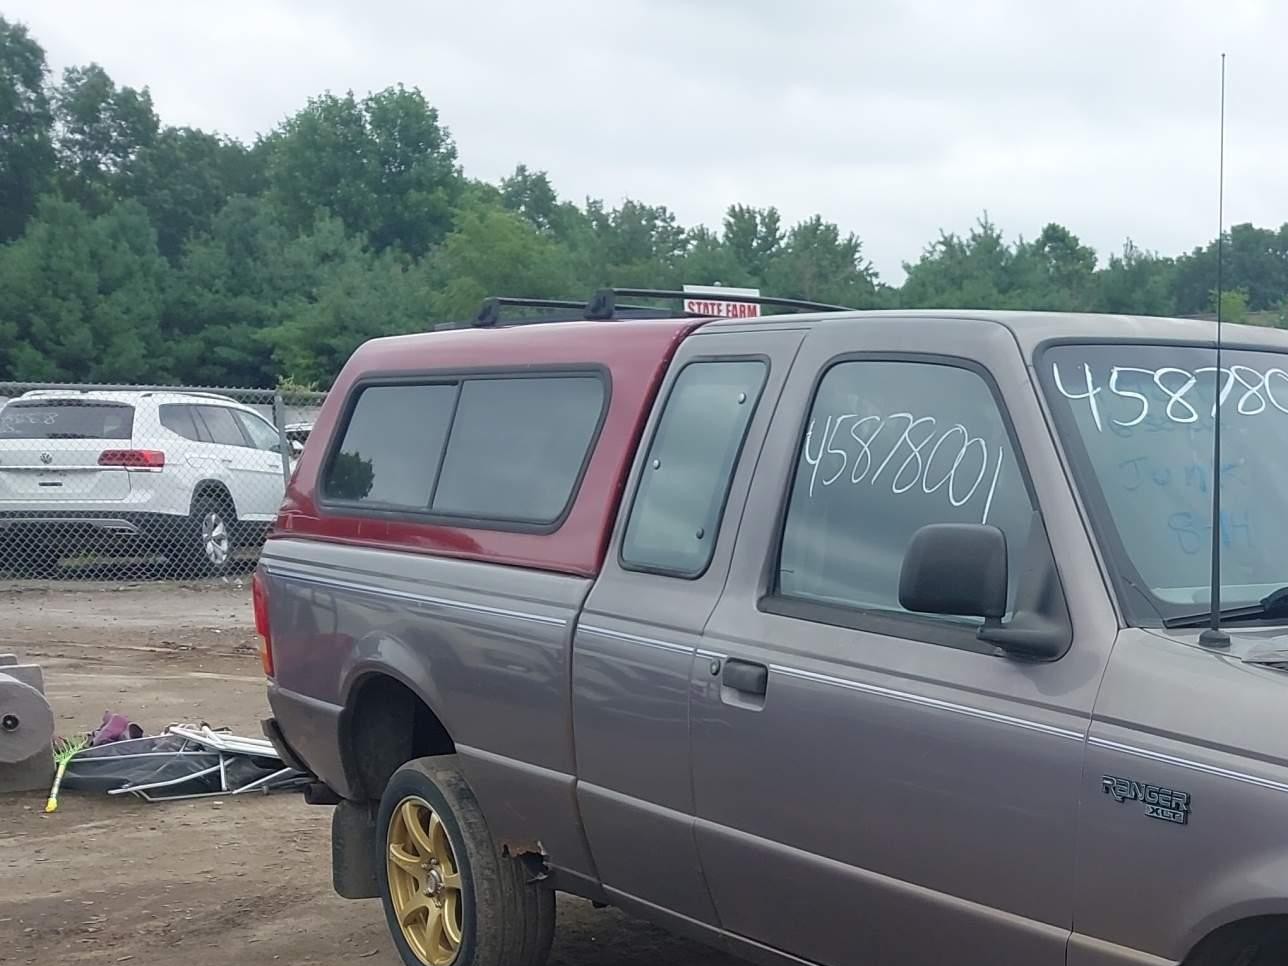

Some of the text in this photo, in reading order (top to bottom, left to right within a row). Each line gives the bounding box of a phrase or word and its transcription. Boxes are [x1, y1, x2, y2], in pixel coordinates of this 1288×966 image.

[687, 301, 757, 317] STATE FARM
[805, 412, 1003, 525] 45878001
[1102, 775, 1190, 812] RANGER
[1147, 805, 1183, 821] XLT
